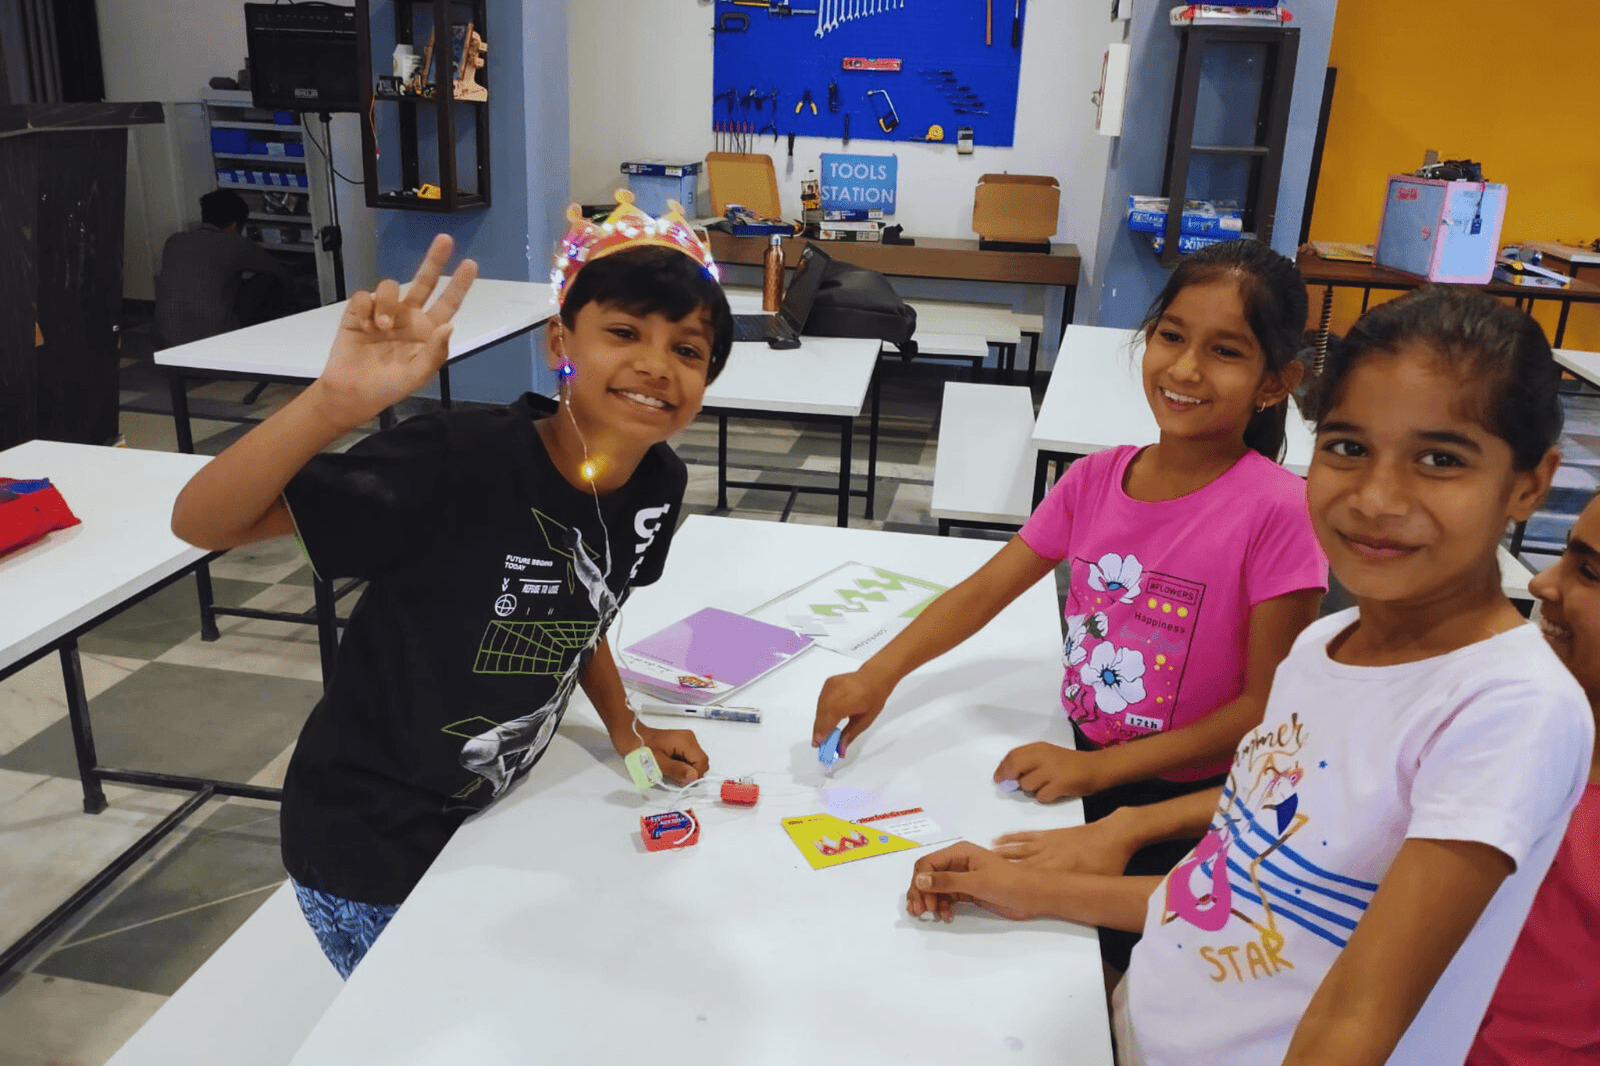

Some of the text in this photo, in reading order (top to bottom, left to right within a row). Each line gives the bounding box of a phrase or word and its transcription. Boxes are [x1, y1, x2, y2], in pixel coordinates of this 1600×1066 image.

[830, 162, 887, 180] TOOLS
[821, 185, 894, 204] STATION
[505, 562, 526, 571] TODAY
[506, 554, 531, 565] FUTURE
[1149, 583, 1194, 600] #FLOWERS
[1134, 612, 1186, 634] Happiness
[1130, 717, 1158, 729] 17th
[1200, 934, 1294, 983] STAR
